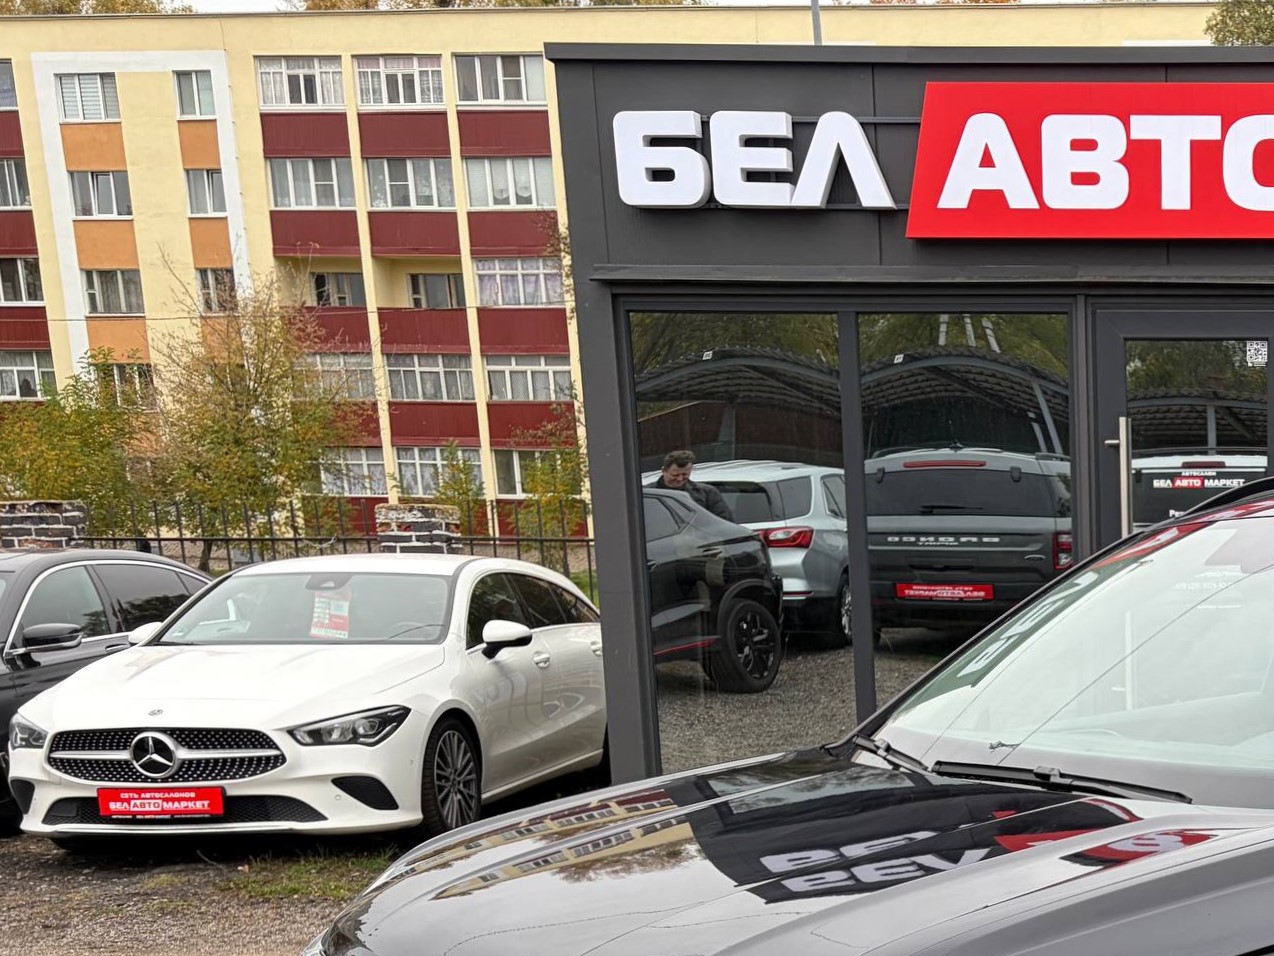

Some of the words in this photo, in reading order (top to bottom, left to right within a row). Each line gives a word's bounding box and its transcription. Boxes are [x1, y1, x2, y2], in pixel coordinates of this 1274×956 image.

[613, 110, 898, 209] БЕЛ
[1153, 479, 1172, 488] БЕЛ
[1174, 478, 1201, 488] АВТО
[1204, 479, 1245, 488] МАРКЕТ
[109, 801, 130, 810] БЕЛ
[132, 801, 161, 809] АВТО
[163, 800, 210, 810] МАРКЕТ
